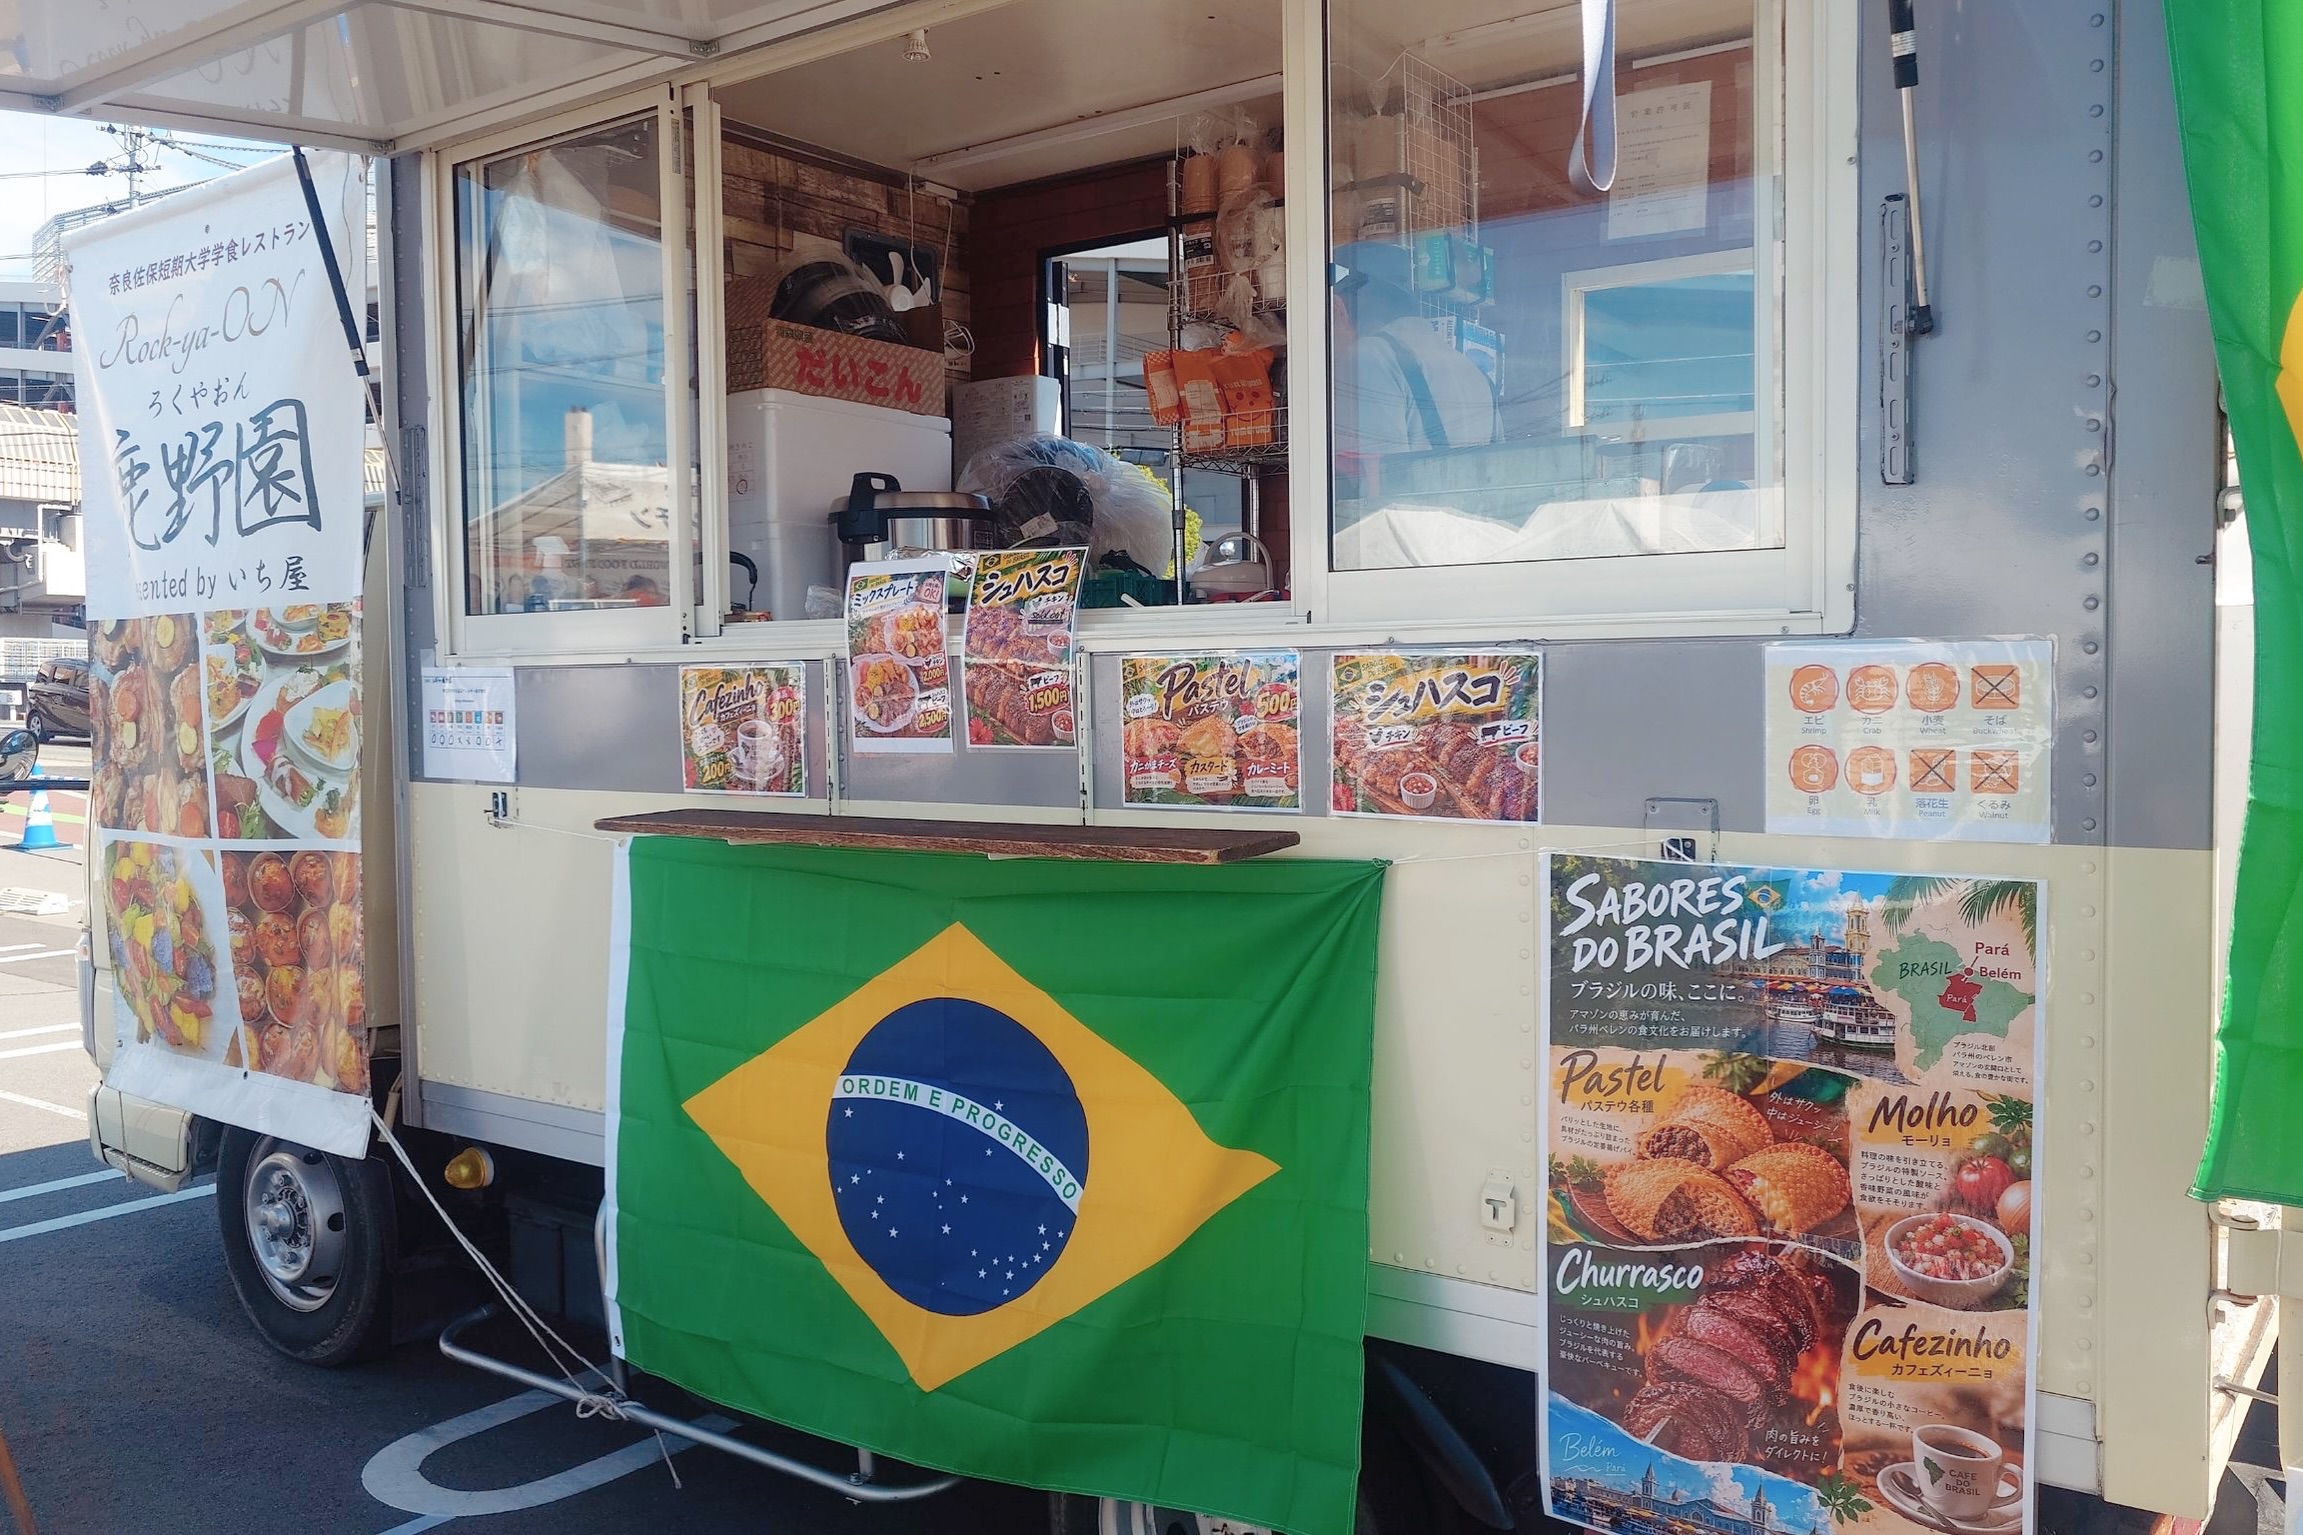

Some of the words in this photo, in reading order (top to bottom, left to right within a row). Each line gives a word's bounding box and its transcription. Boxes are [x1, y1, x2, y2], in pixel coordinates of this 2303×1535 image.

[109, 221, 311, 296] 奈良佐保短期大学学食レストラン
[796, 345, 923, 404] だいこん
[149, 371, 249, 418] ろくやおん
[196, 566, 216, 600] by
[228, 555, 310, 593] いち屋
[982, 564, 1070, 604] シュハスコ
[852, 580, 915, 610] ミックスプレート
[923, 588, 940, 601] OK!
[1030, 609, 1048, 620] sold
[1050, 609, 1065, 620] out
[1042, 674, 1060, 685] ビーフ
[1156, 658, 1251, 720] Pastel
[1365, 672, 1501, 721] シュハスコ
[689, 672, 764, 726] Cafezinho
[1028, 687, 1068, 713] 1,500円
[1255, 691, 1298, 719] 500円
[769, 698, 800, 722] 300円
[1187, 700, 1229, 717] パステウ
[1804, 715, 1824, 726] エビ
[1861, 715, 1883, 726] カニ
[1922, 715, 1945, 726] 小麦
[1984, 715, 2007, 726] そば
[1385, 728, 1411, 742] チキン
[1502, 724, 1529, 736] ビーフ
[1801, 727, 1827, 737] Shrimp
[1863, 727, 1882, 735] Crab
[1919, 727, 1947, 736] Wheat
[1130, 757, 1177, 773] カニかまチーズ
[1189, 759, 1228, 775] カスタード
[1247, 761, 1290, 775] カレーミート
[1808, 796, 1819, 806] 卵
[1867, 797, 1878, 807] 乳
[1915, 798, 1949, 809] 落花生
[1978, 800, 2011, 810] くるみ
[1807, 807, 1821, 817] Egg
[1863, 808, 1881, 817] Milk
[1918, 809, 1946, 818] Peanut
[1979, 811, 2008, 820] Walnut
[1559, 872, 1747, 937] SABORES
[1571, 937, 1619, 974] DO
[1624, 916, 1787, 974] BRASIL
[1975, 942, 2010, 956] Pará
[1899, 961, 1952, 980] BRASIL
[1979, 966, 2022, 980] Belém
[1570, 981, 1745, 1002] ブラジルの味、ここに。
[1946, 993, 1967, 1004] Pará
[1569, 1008, 1687, 1022] アマゾンの恵みが育んだ、
[1569, 1024, 1748, 1038] パラ州ベレンの食文化をお届けします。
[1953, 1041, 1996, 1052] ブラジル北部
[1952, 1051, 2013, 1063] パラ州のベレン市
[1952, 1061, 2022, 1074] アマゾンの玄関口として
[1559, 1050, 1667, 1105] Pastel
[1580, 1099, 1655, 1114] パステウ各種
[1768, 1091, 1822, 1113] 外はサクッ
[1868, 1091, 1978, 1133] Molho
[842, 1078, 919, 1102] ORDEM
[929, 1089, 943, 1108] E
[951, 1097, 1078, 1200] PROGRESSO
[1901, 1135, 1951, 1147] モーリョ
[1860, 1151, 1949, 1170] 料理の味を引き立てる、
[1860, 1162, 1948, 1181] ブラジルの特製ソース。
[1860, 1172, 1941, 1190] さっぱりとした酸味と
[1860, 1183, 1929, 1199] 香味野菜の風味が
[1859, 1194, 1927, 1211] 食欲をそそります。
[1556, 1247, 1704, 1295] Churrasco
[1581, 1294, 1639, 1308] シュハスコ
[1559, 1313, 1631, 1339] じっくりと焼き上げた
[1852, 1318, 2012, 1361] Cafezinho
[1559, 1338, 1624, 1362] ブラジルを代表する
[1559, 1350, 1643, 1378] 豪快なバーベキューです。
[1891, 1363, 1993, 1379] カフェズィーニョ
[1848, 1383, 1895, 1399] 食後に楽しむ
[1848, 1403, 1906, 1423] 濃厚で香り高い、
[1849, 1393, 1946, 1420] ブラジルの小さなコーヒー。
[1848, 1413, 1914, 1434] ほっとする一杯です。
[1765, 1428, 1820, 1447] 肉の旨みを
[1559, 1433, 1621, 1461] Belém
[1764, 1444, 1828, 1463] ダイレクトに!
[1605, 1462, 1626, 1473] Pará
[1949, 1469, 1978, 1481] CAFE
[1945, 1483, 1982, 1497] BRASIL
[1956, 1479, 1970, 1488] DO
